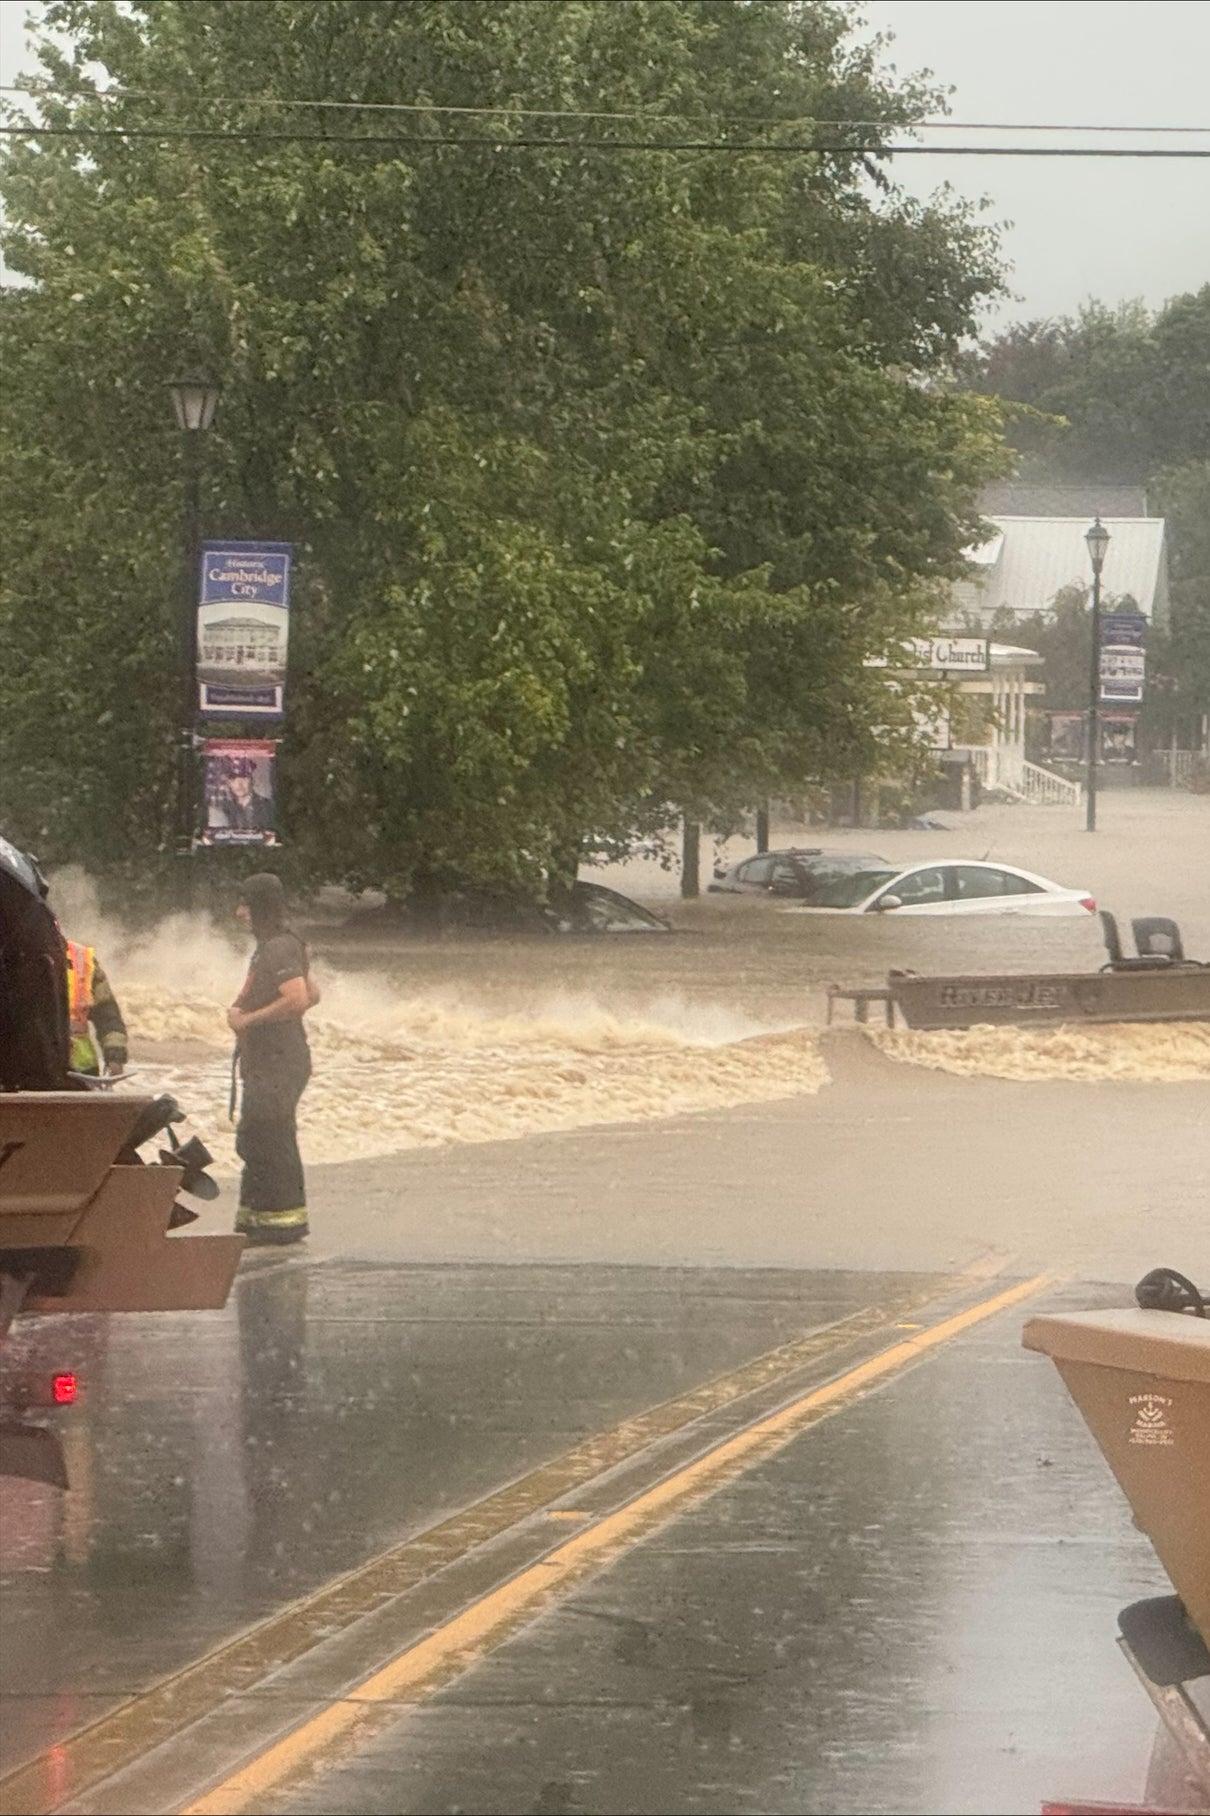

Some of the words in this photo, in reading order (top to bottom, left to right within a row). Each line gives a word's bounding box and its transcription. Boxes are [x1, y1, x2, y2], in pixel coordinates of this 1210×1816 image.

[208, 568, 282, 587] Cambridge
[230, 583, 258, 598] City
[936, 643, 985, 663] Church
